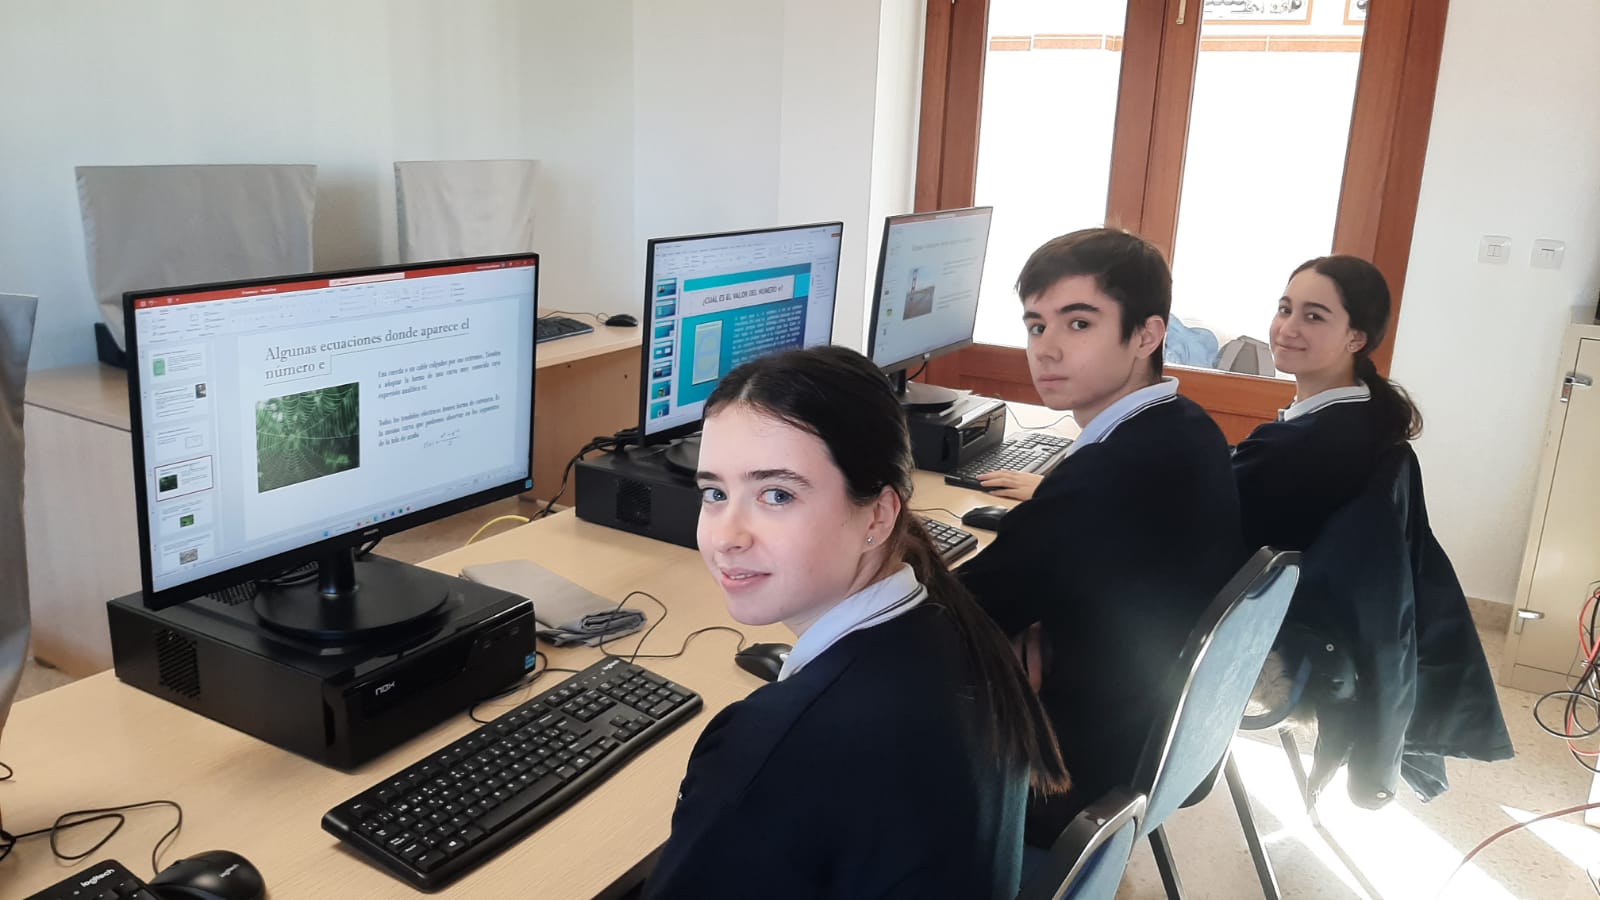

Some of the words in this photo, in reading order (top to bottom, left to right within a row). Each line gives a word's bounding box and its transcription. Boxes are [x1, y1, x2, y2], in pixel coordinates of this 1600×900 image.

[265, 343, 317, 363] Algunas
[320, 335, 382, 352] ecuaciones
[385, 326, 418, 342] donde
[420, 322, 458, 340] aparece
[460, 318, 470, 330] el
[265, 360, 315, 379] número
[318, 362, 325, 370] e
[80, 869, 115, 887] logitech
